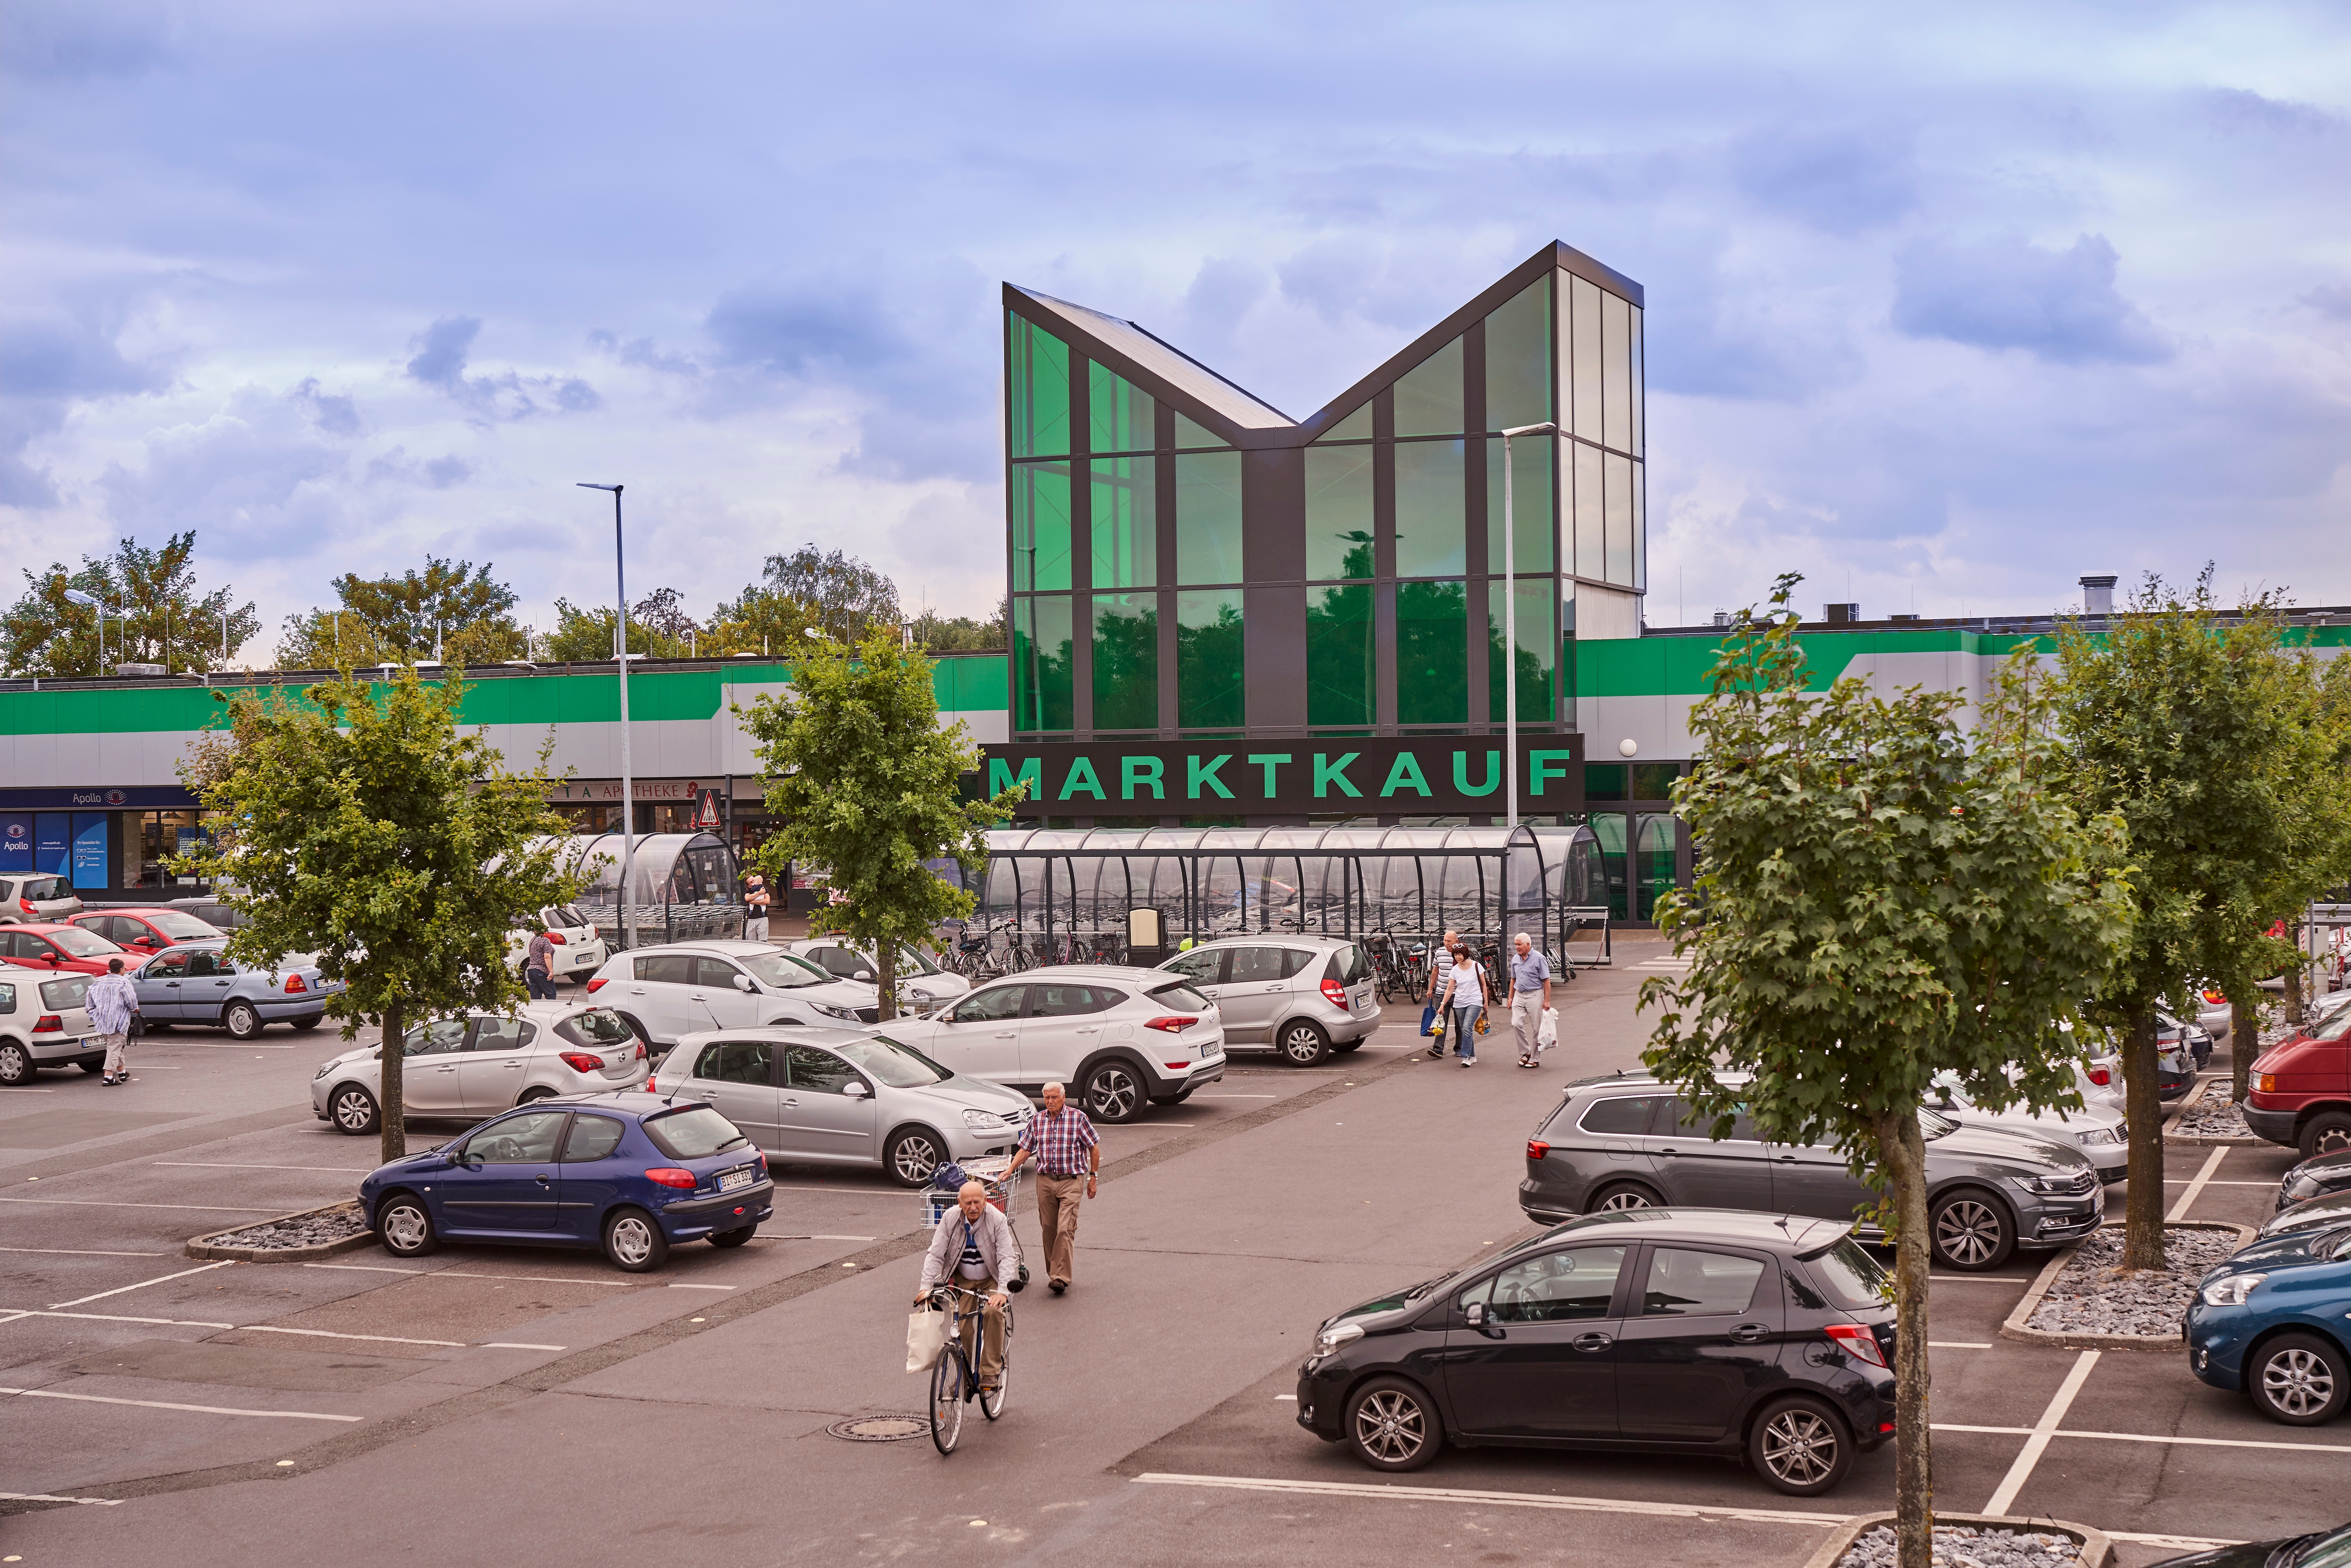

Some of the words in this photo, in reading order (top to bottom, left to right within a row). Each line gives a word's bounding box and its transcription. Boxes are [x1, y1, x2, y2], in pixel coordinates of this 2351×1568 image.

[988, 749, 1570, 801] MARKTKAUF
[603, 785, 679, 798] APTHEKE
[73, 793, 101, 805] Apollo
[4, 841, 28, 852] Apollo
[721, 1177, 730, 1187] BI
[733, 1174, 741, 1184] SI
[741, 1170, 751, 1182] 331
